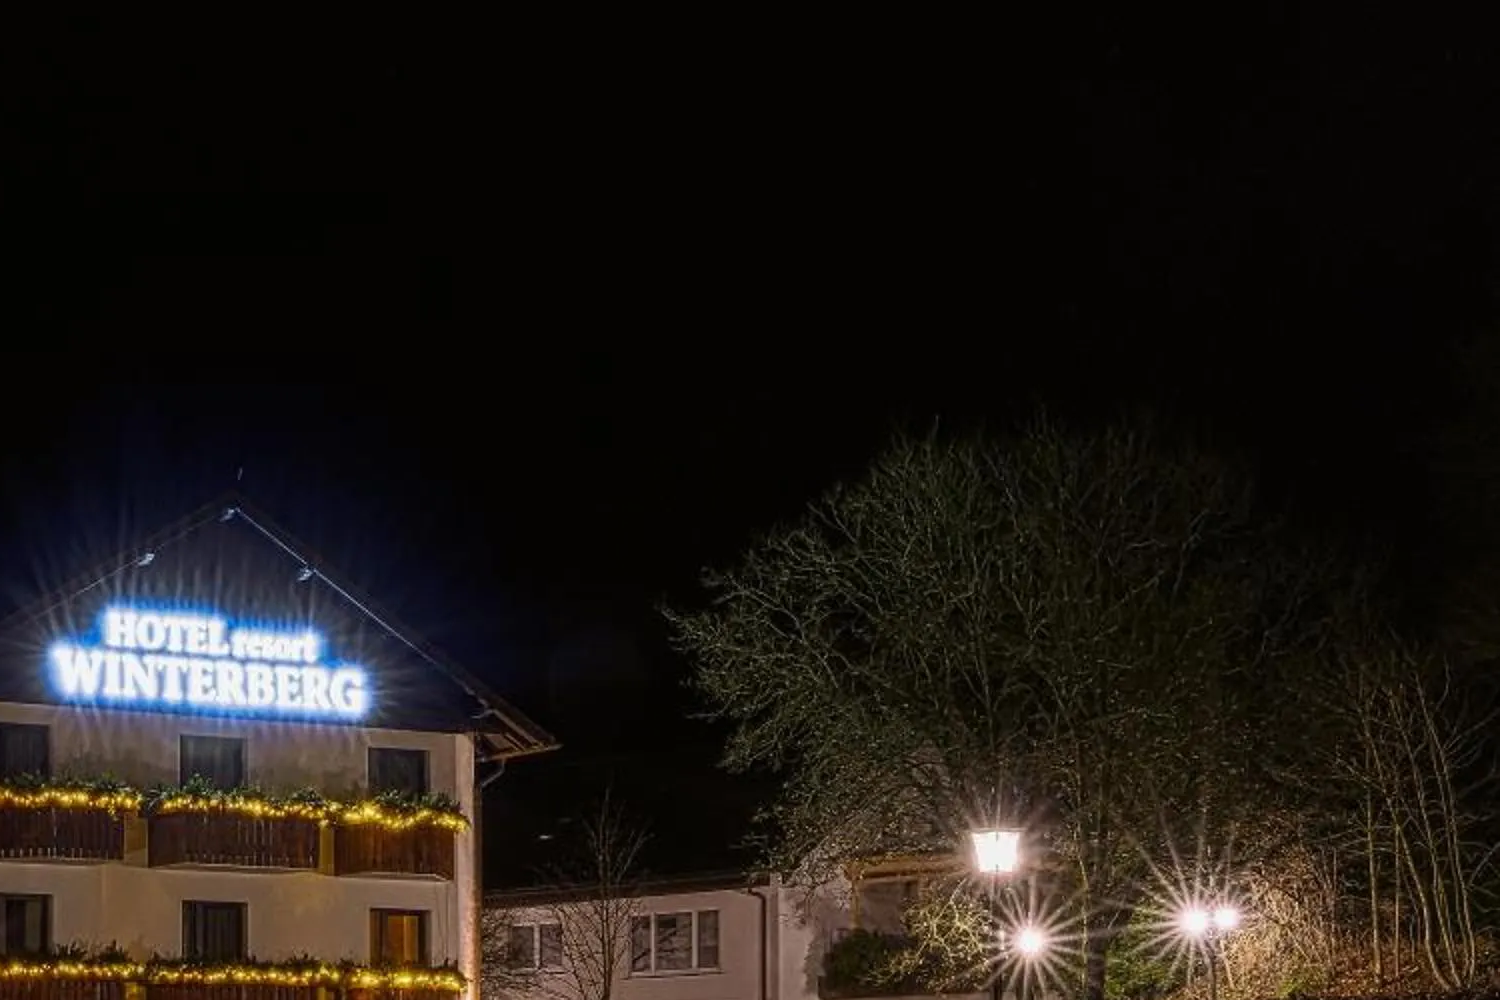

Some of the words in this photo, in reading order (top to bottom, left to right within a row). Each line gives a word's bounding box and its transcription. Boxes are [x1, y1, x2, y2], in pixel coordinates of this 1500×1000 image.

[106, 609, 228, 656] HOTEL
[232, 628, 319, 664] resort
[51, 644, 369, 716] WINTERBERG
